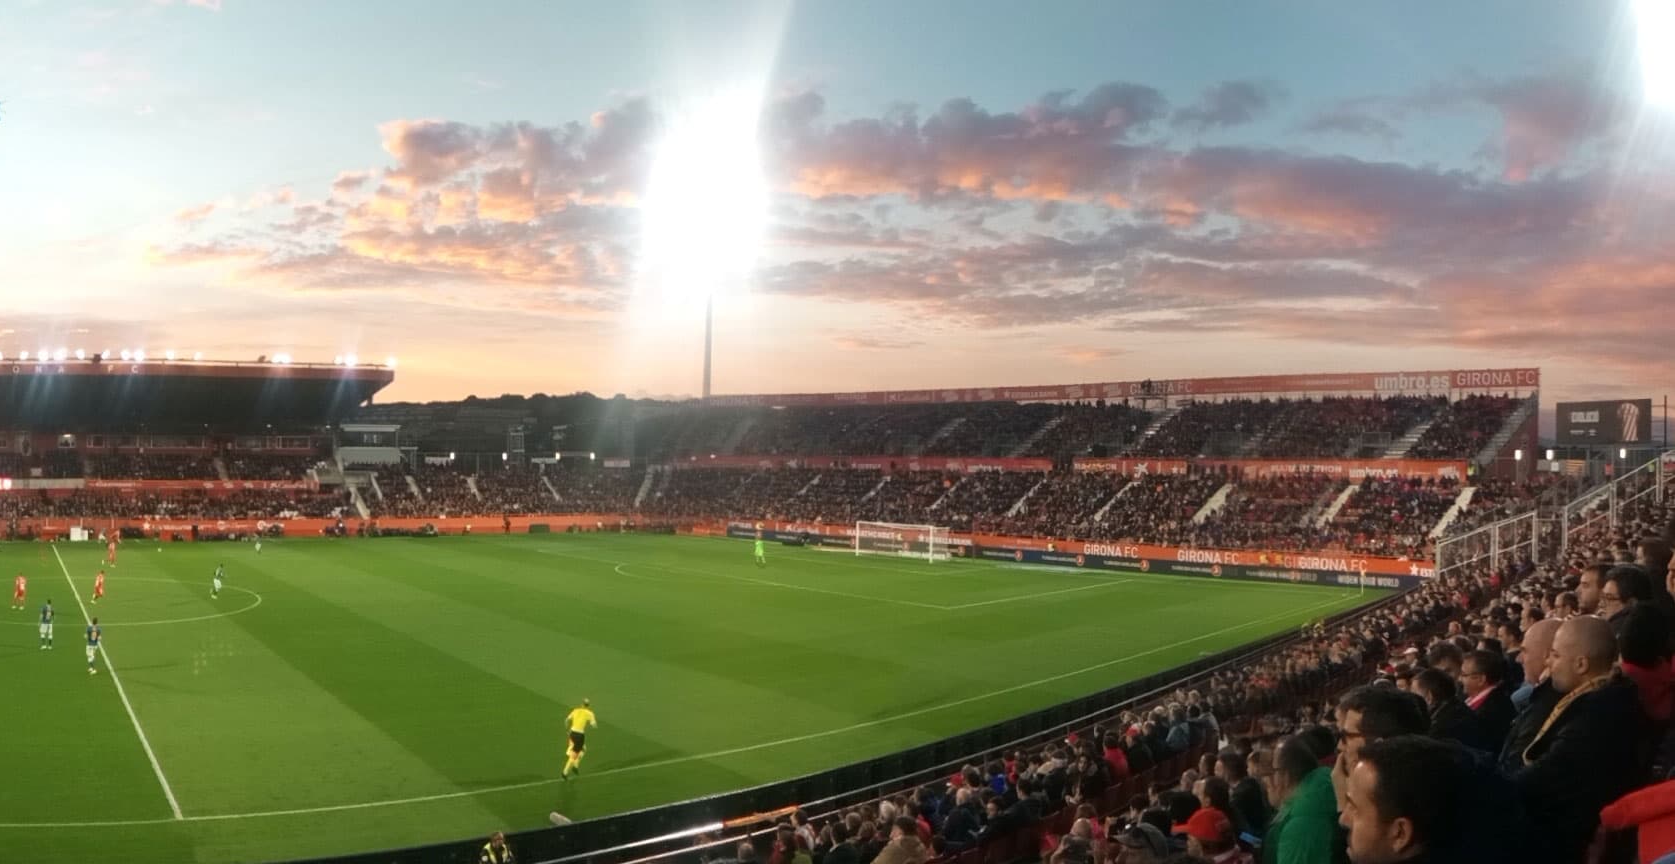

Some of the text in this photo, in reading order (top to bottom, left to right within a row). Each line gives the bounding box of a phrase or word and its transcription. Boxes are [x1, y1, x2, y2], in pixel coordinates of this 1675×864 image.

[1374, 373, 1450, 390] umbro.es
[1456, 370, 1535, 386] GIRONA FC
[1083, 544, 1138, 558] GIRONA FC
[1177, 549, 1239, 565] GIRONA FC
[1350, 559, 1368, 572] FC
